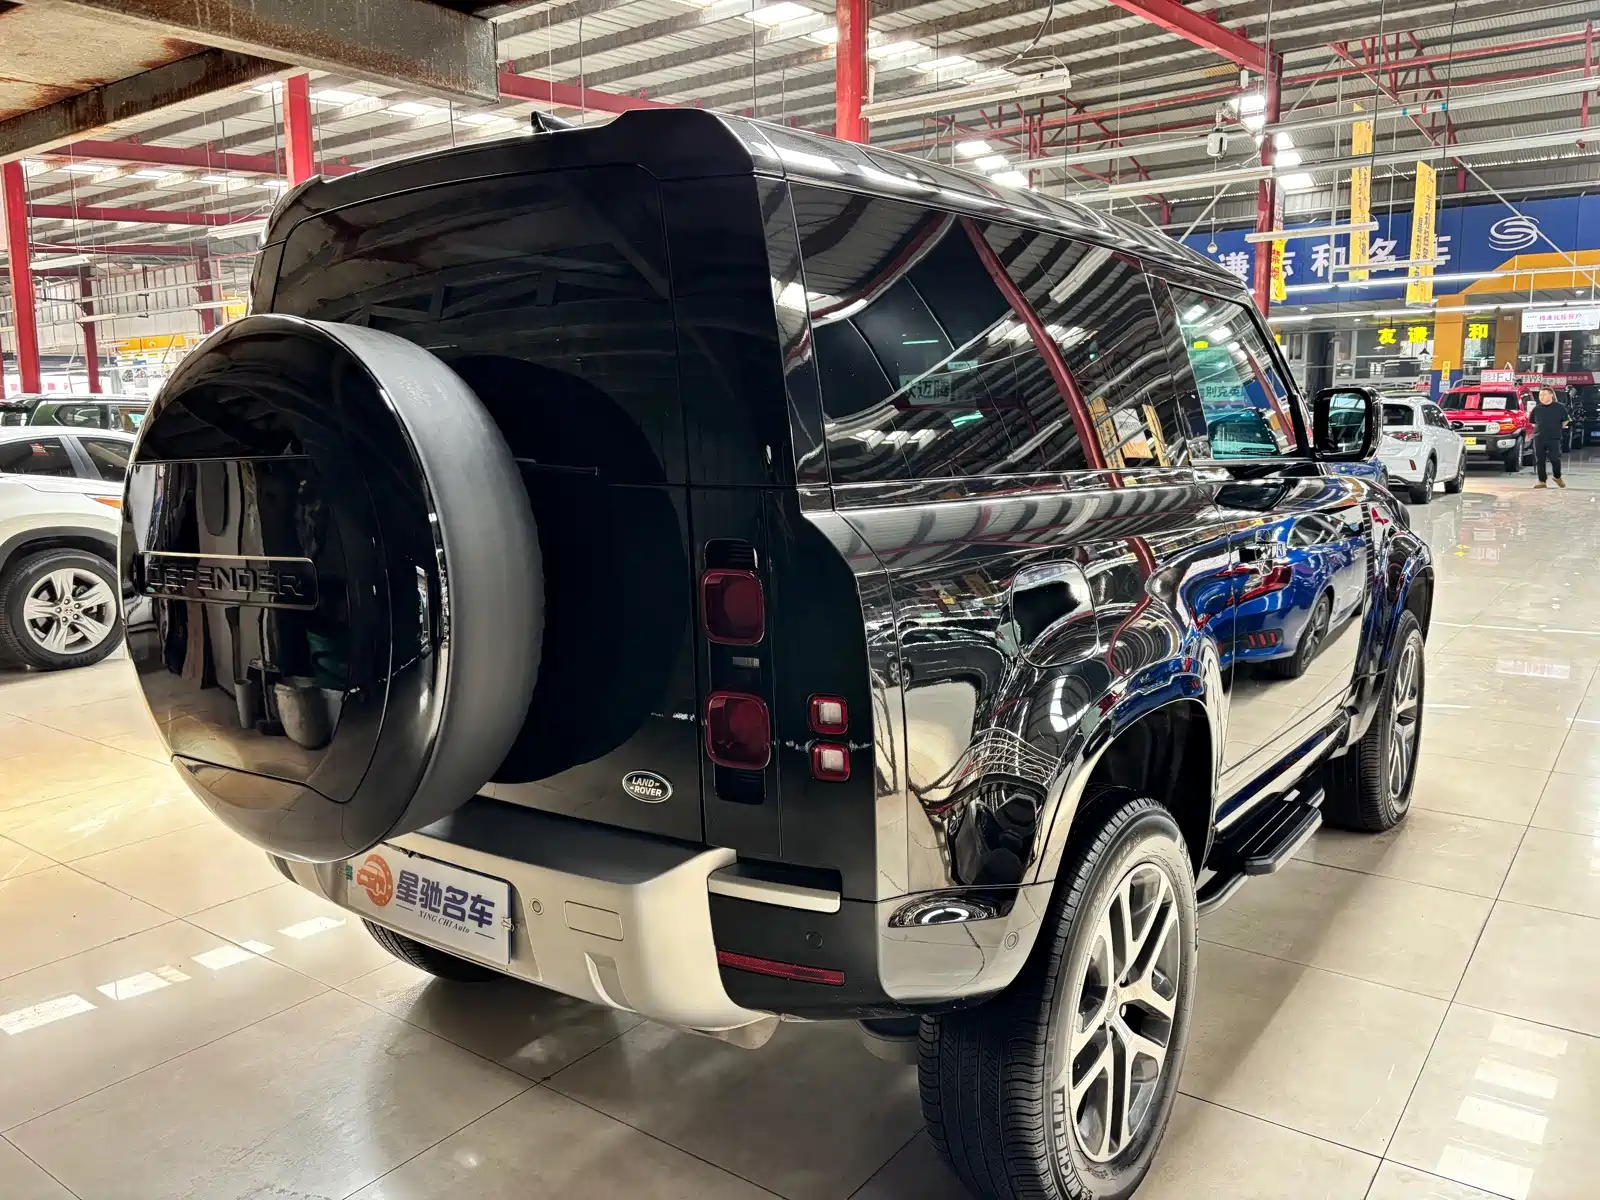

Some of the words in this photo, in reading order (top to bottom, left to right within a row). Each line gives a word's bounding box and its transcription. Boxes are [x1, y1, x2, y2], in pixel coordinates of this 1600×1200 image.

[1205, 385, 1244, 398] 别克英
[147, 563, 304, 597] DEFENDER
[632, 776, 655, 788] LAND
[634, 785, 662, 797] ROVER
[396, 869, 495, 928] 星驰名车
[418, 910, 437, 922] XING
[438, 917, 453, 928] CHI
[453, 923, 470, 934] Auto
[1052, 1092, 1082, 1198] MICHELIN
